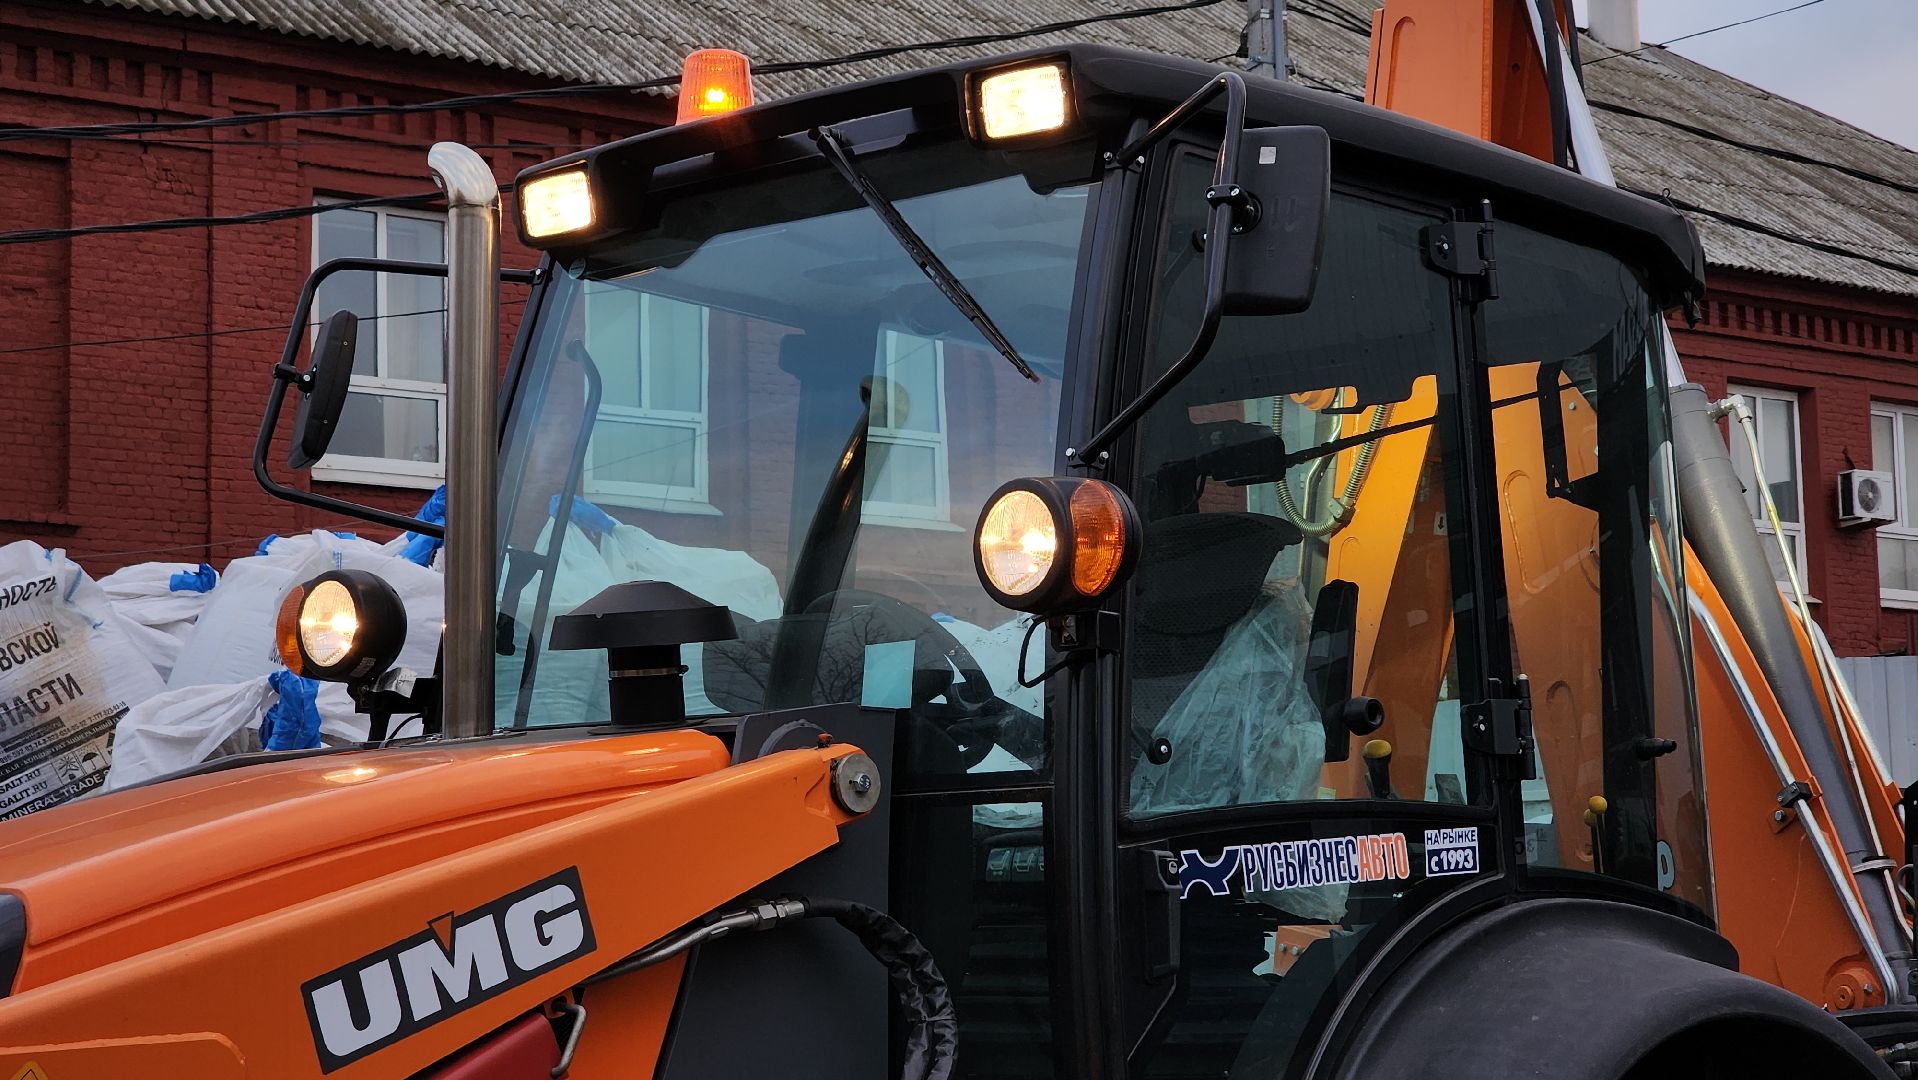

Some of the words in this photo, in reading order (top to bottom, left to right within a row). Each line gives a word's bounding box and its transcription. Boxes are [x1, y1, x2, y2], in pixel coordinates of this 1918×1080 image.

[0, 621, 59, 671] ВСКОЙ
[1, 794, 61, 822] MINERAL
[60, 773, 104, 798] TRADE
[1427, 831, 1440, 845] НА
[1442, 829, 1476, 844] РЫНКЕ
[1242, 833, 1409, 892] РУСБИЗНЕСАВТО
[311, 884, 584, 1057] UMG
